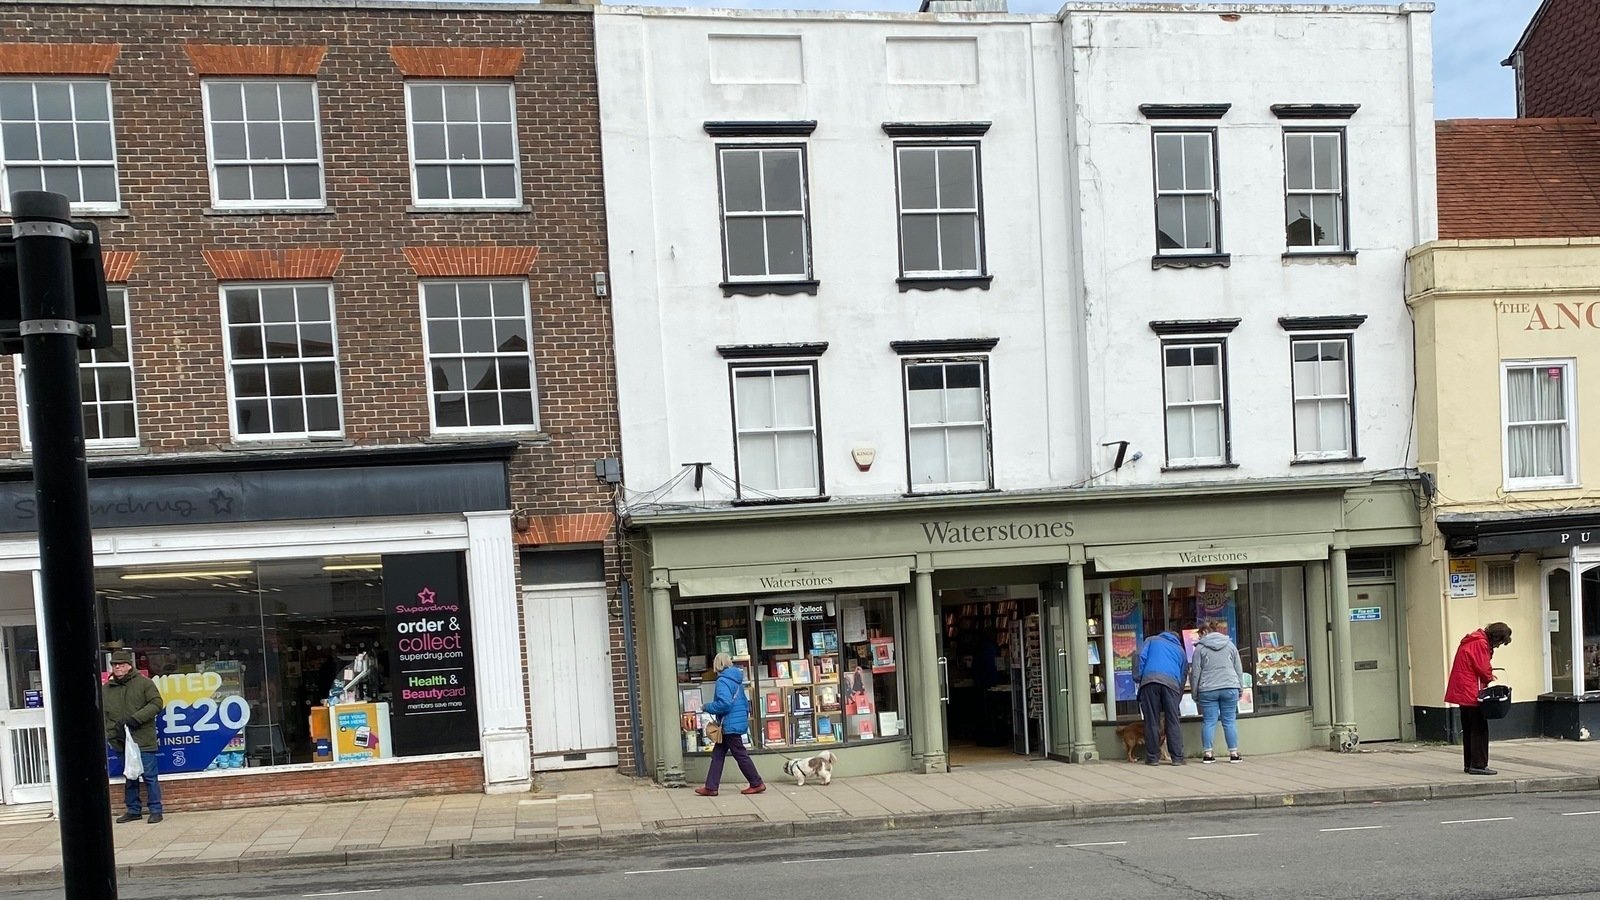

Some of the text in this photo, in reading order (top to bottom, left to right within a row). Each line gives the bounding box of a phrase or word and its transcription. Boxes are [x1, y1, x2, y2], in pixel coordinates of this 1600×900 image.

[1500, 303, 1530, 314] THE
[15, 496, 197, 520] Srdrug
[920, 520, 1075, 545] Waterstones
[1179, 550, 1248, 563] Waterstones
[760, 574, 834, 589] Waterstones
[396, 603, 459, 613] Superdrug
[772, 607, 791, 615] Click
[798, 605, 823, 613] Collect
[397, 616, 461, 634] order &
[773, 615, 823, 623] Waterstones.com
[398, 633, 461, 652] collect
[399, 651, 463, 662] superdrug.com
[409, 674, 459, 687] Health &
[402, 686, 466, 701] Beautycard
[408, 702, 434, 710] members
[448, 700, 463, 708] more
[163, 695, 251, 734] £20
[164, 735, 201, 746] INSIDE
[172, 750, 187, 767] 3
